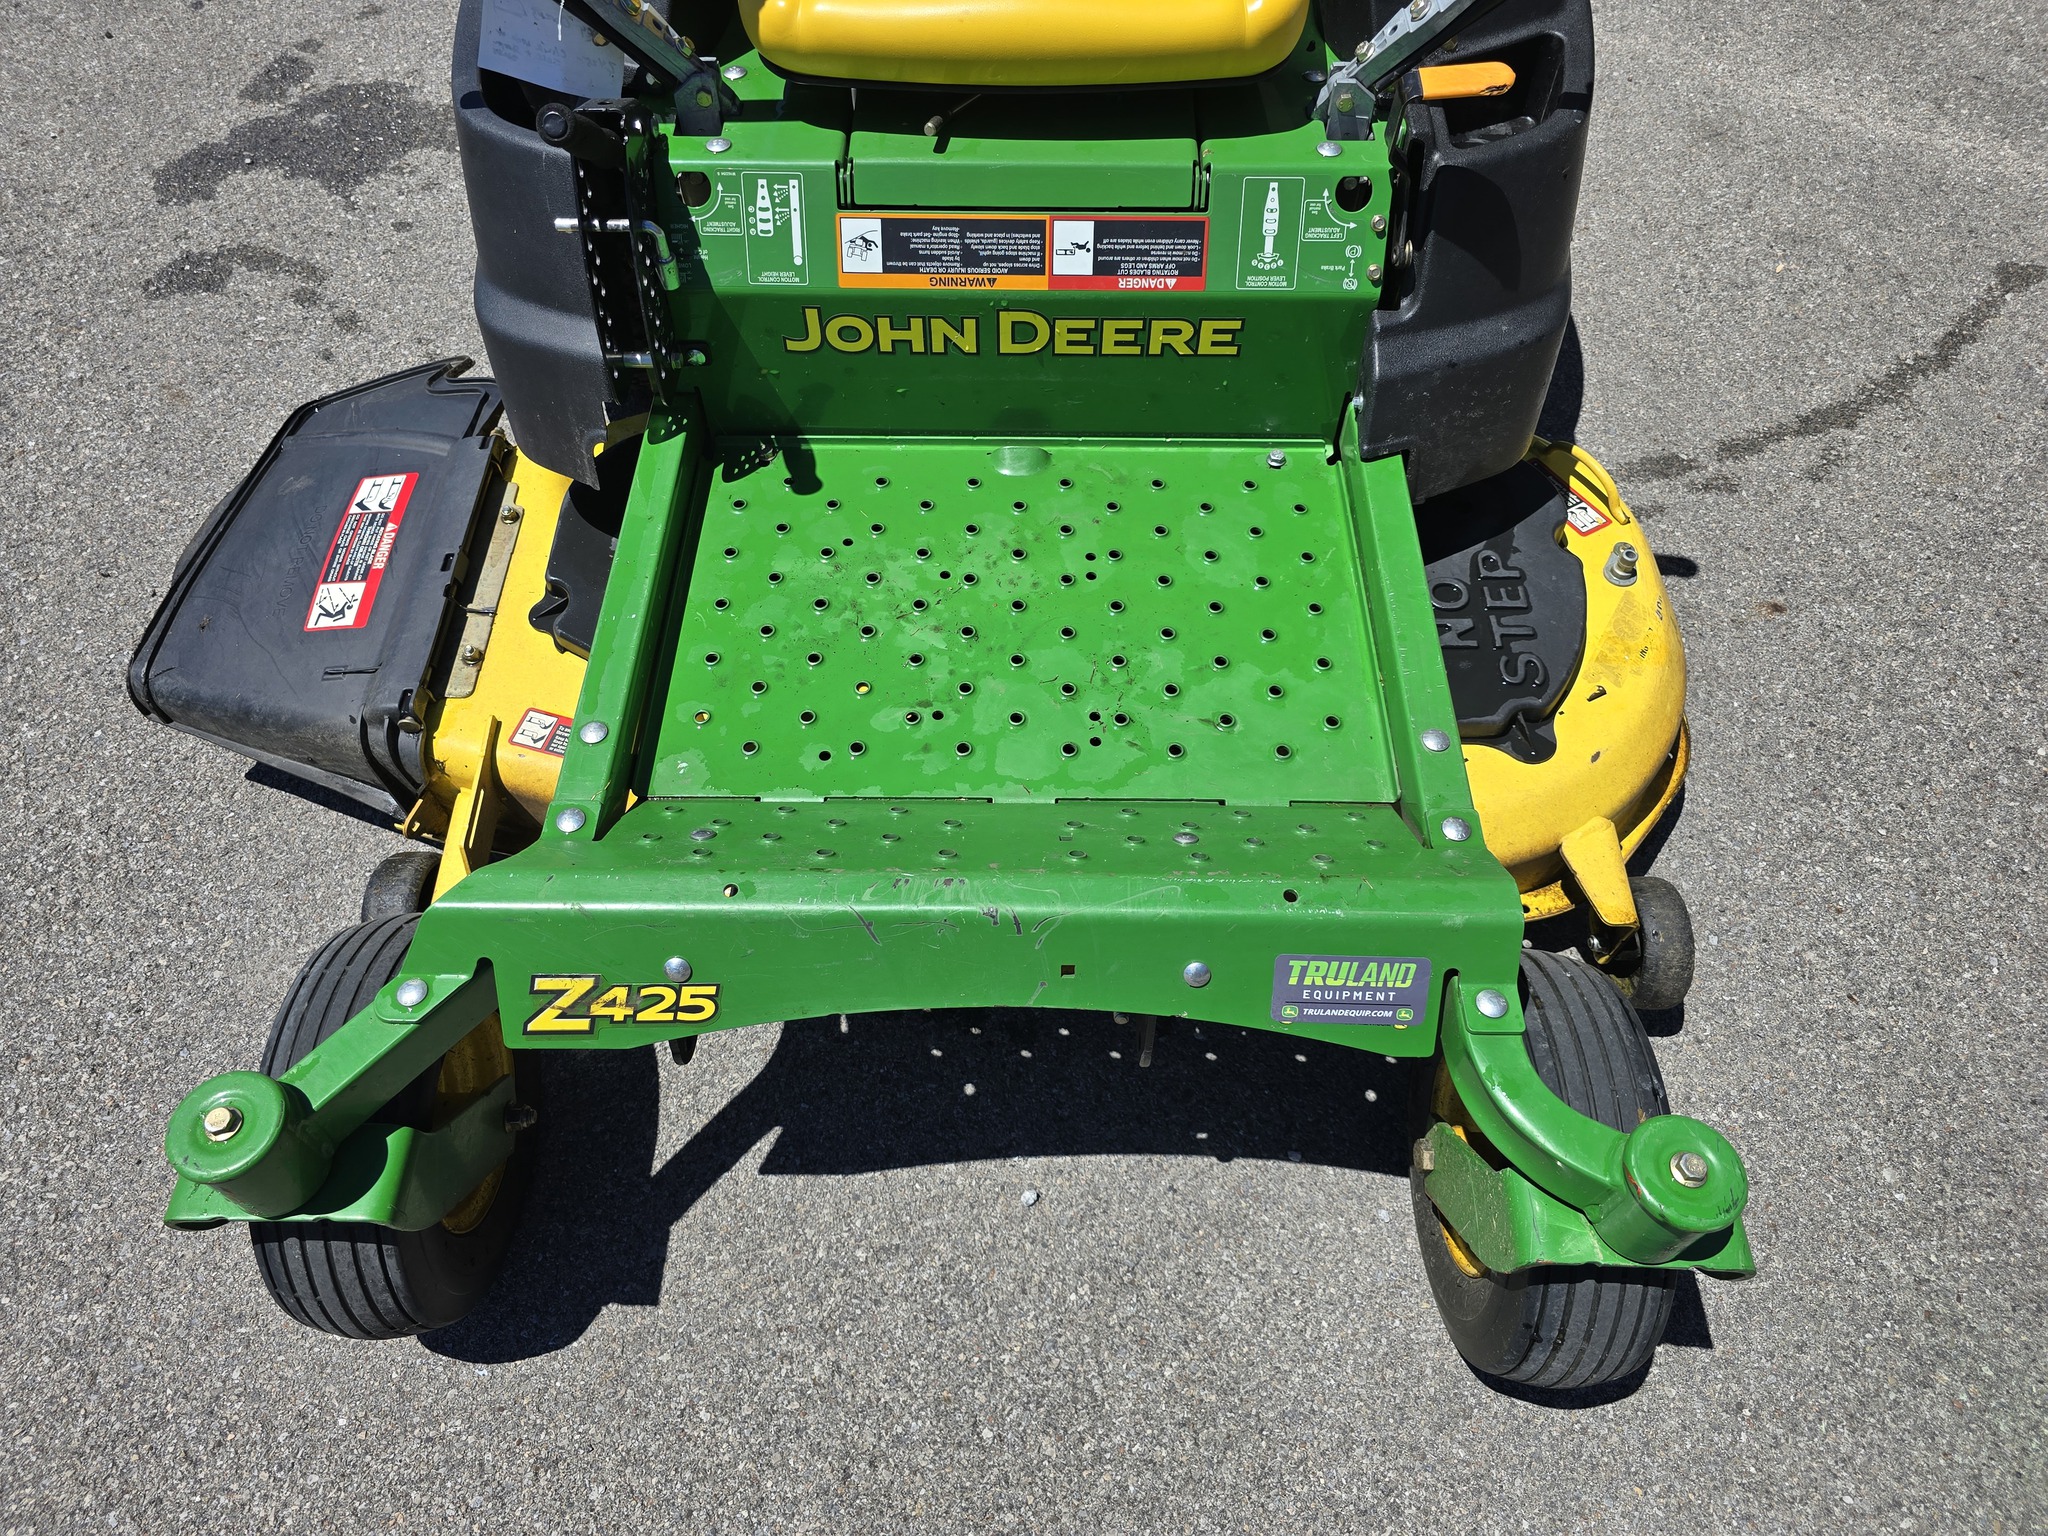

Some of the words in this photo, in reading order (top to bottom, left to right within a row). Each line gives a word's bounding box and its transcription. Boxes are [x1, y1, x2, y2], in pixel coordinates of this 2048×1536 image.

[929, 276, 986, 288] WARNING
[1118, 278, 1164, 288] DANGER
[784, 305, 979, 355] JOHN
[997, 309, 1243, 358] DEERE
[372, 532, 396, 570] DANGER
[1429, 578, 1478, 650] NO
[1477, 550, 1547, 686] STEP
[1288, 960, 1417, 988] TRULAND
[523, 974, 720, 1034] Z425
[1302, 989, 1396, 1002] EQUIPMENT
[1302, 1008, 1393, 1018] TRULANDEQUIP.COM
